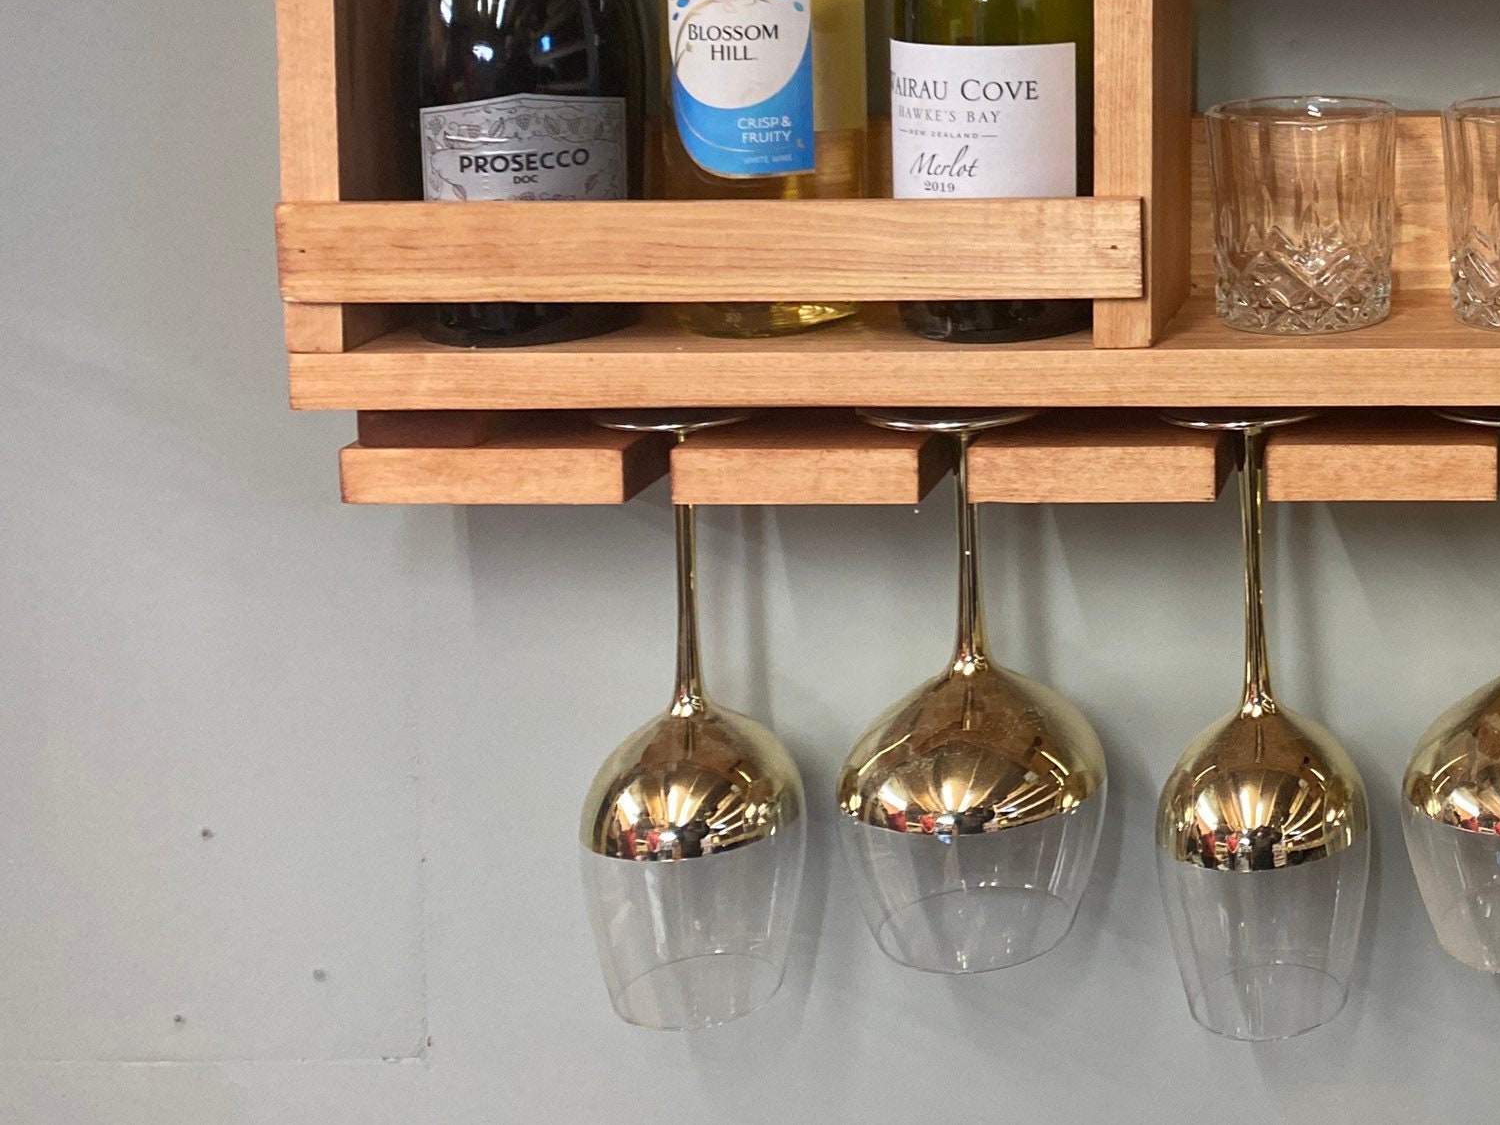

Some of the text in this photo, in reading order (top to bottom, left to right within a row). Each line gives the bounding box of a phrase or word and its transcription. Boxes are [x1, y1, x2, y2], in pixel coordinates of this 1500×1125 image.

[687, 23, 780, 41] BLOSSOM
[710, 45, 753, 61] HILL
[960, 79, 1039, 101] COVE
[738, 115, 792, 129] CRISP &
[898, 105, 1001, 123] HAWKE'S BAY
[742, 130, 792, 144] FRUITY
[931, 131, 979, 139] ZEALAND
[459, 149, 590, 173] PROSECCO
[910, 145, 980, 177] Merlot
[513, 175, 538, 185] DOC
[924, 181, 956, 193] 2019
